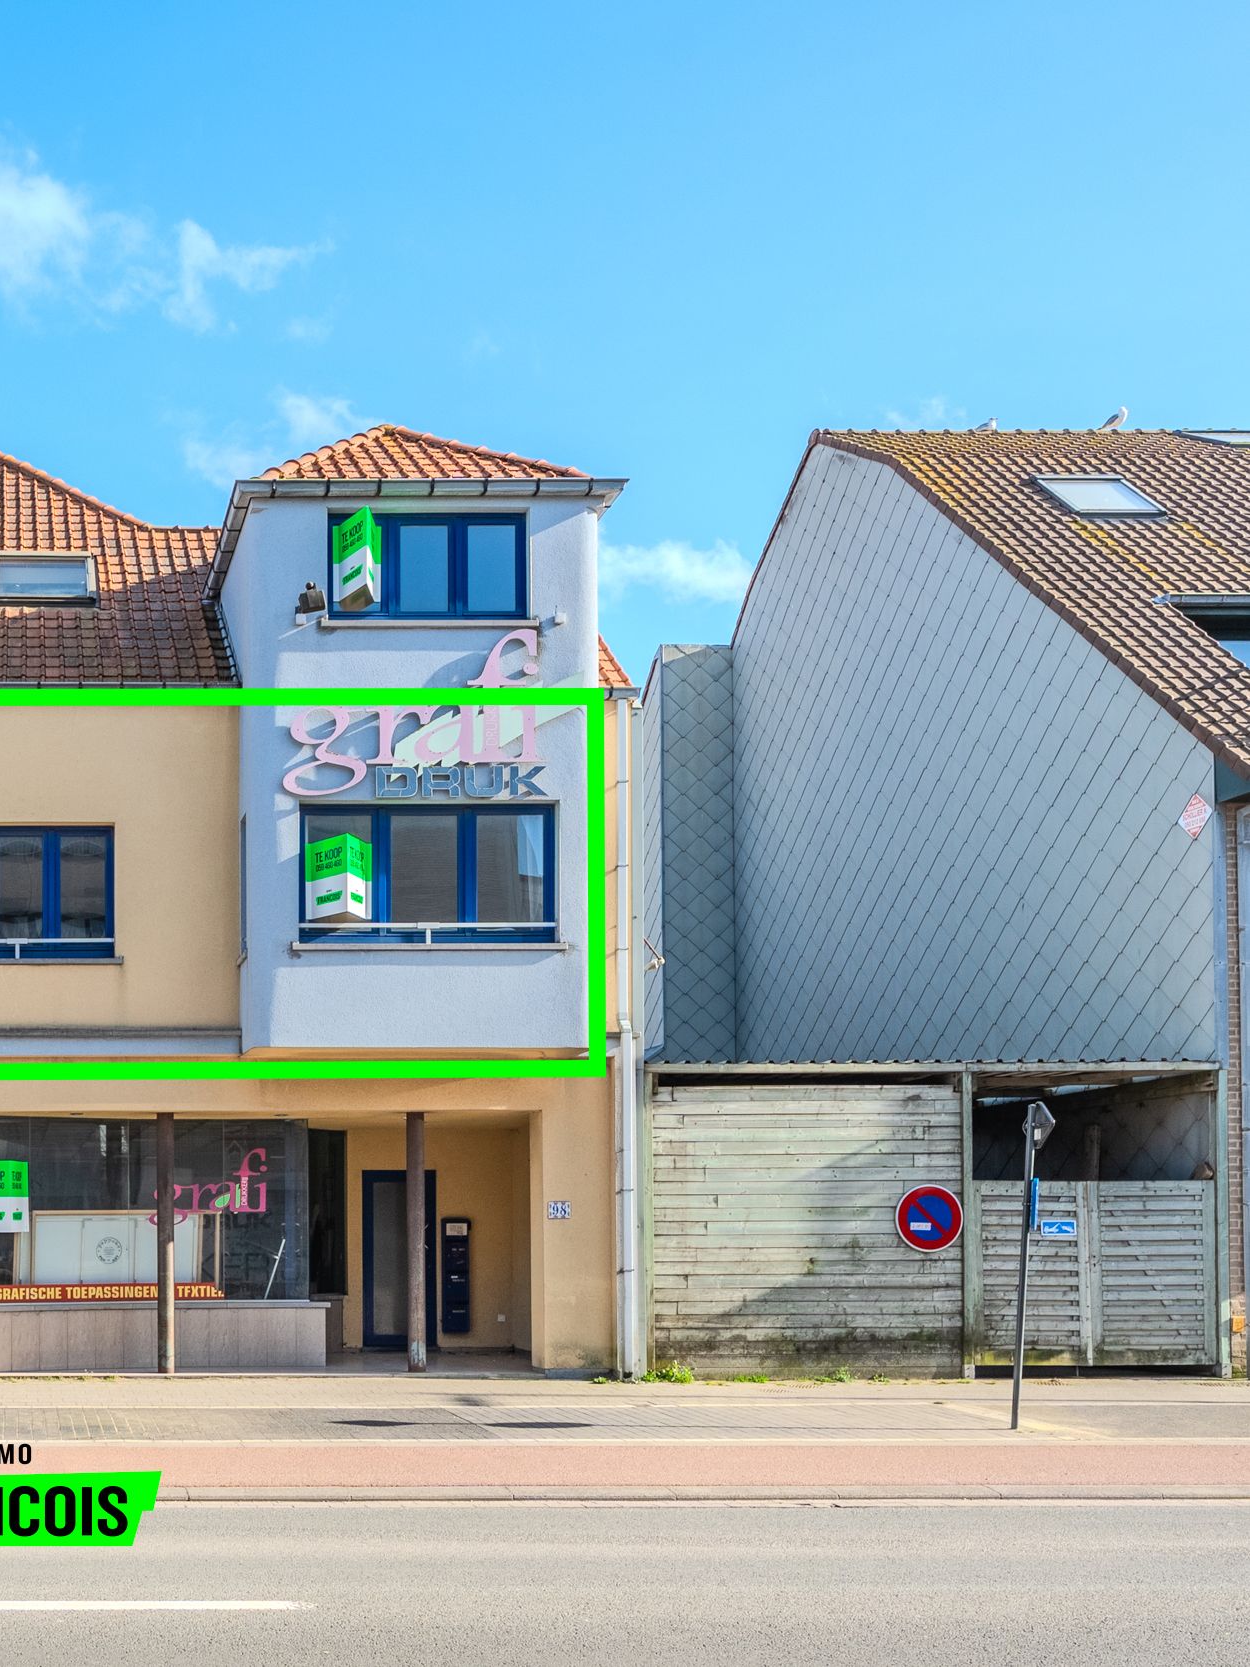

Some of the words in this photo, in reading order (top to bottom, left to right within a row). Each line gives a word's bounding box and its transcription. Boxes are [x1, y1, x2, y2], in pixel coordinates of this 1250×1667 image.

[282, 628, 541, 796] grafi
[375, 766, 549, 798] DRUK
[315, 851, 324, 863] TE
[324, 846, 343, 860] KOOP
[552, 1205, 567, 1216] 98
[65, 1285, 159, 1300] TOEPASSINGEN
